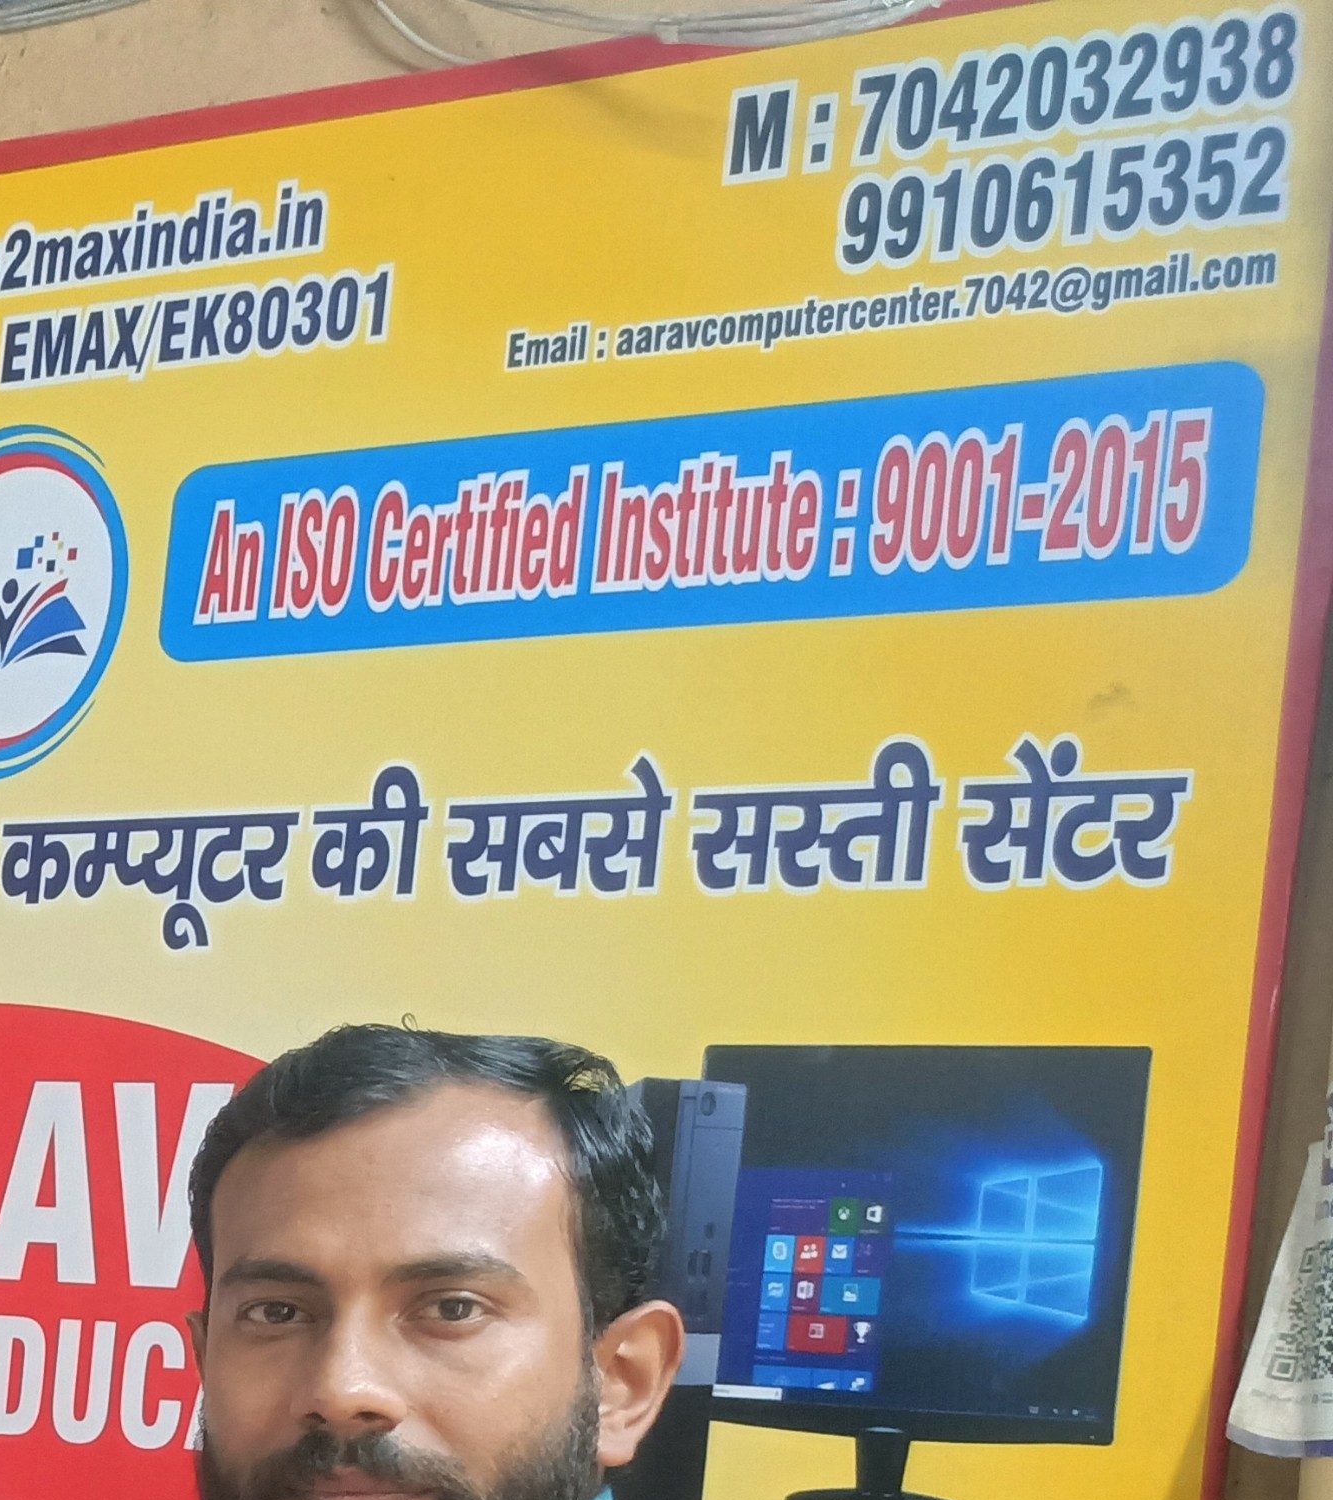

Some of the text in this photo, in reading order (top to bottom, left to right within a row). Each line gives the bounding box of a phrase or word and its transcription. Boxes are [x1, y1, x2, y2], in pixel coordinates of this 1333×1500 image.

[730, 13, 1298, 176] M : 7042032938
[843, 128, 1285, 266] 9910615352
[1, 271, 389, 383] EMAX/EK80301
[507, 253, 1277, 369] Email : aaravcomputercenter.7042@gmail.com
[201, 415, 1210, 614] An ISO Certified Institute : 9001-2015
[1, 812, 299, 950] कम्प्यूटर
[312, 766, 428, 896] की
[447, 756, 672, 892] सबसे
[692, 741, 941, 889] सस्ती
[961, 739, 1188, 886] सेंटर
